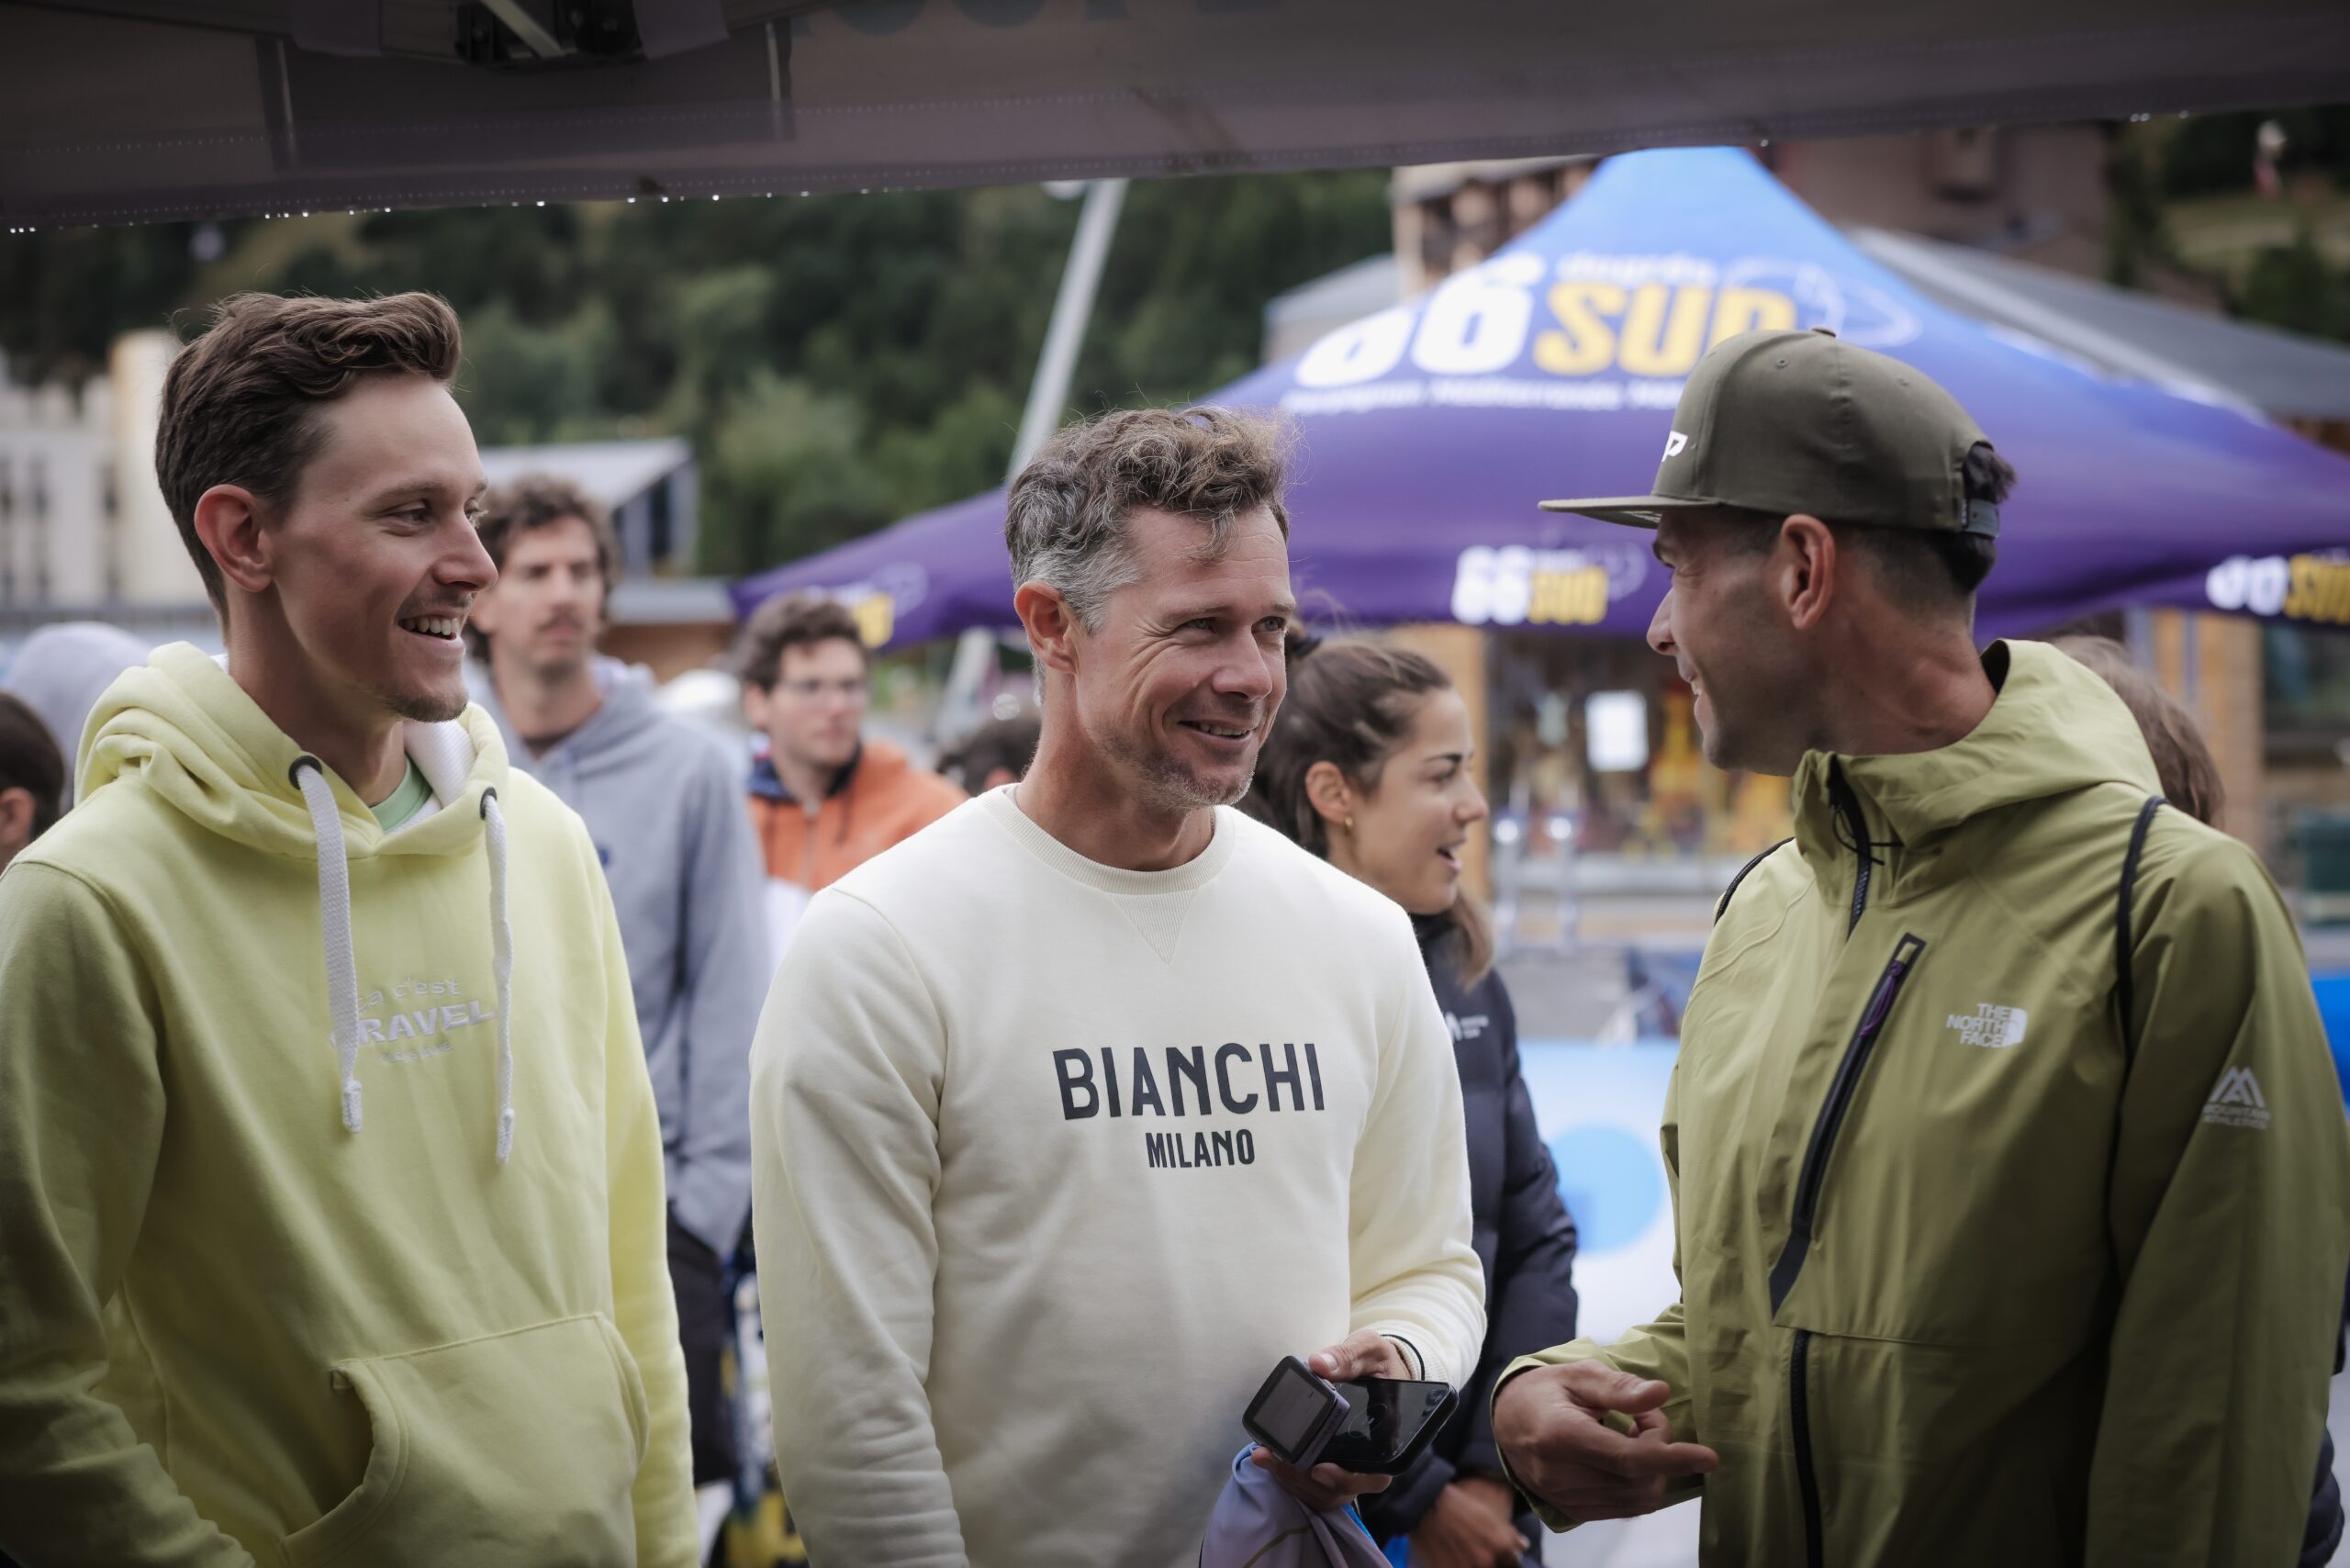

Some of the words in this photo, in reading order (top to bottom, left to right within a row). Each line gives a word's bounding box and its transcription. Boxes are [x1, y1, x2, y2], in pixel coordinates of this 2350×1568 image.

[330, 1000, 497, 1047] RAVEL
[1946, 1013, 2007, 1035] NORTH
[1976, 1002, 2012, 1020] THE
[1959, 1030, 2004, 1048] FACE
[1053, 1042, 1325, 1120] BIANCHI
[1146, 1128, 1255, 1168] MILANO
